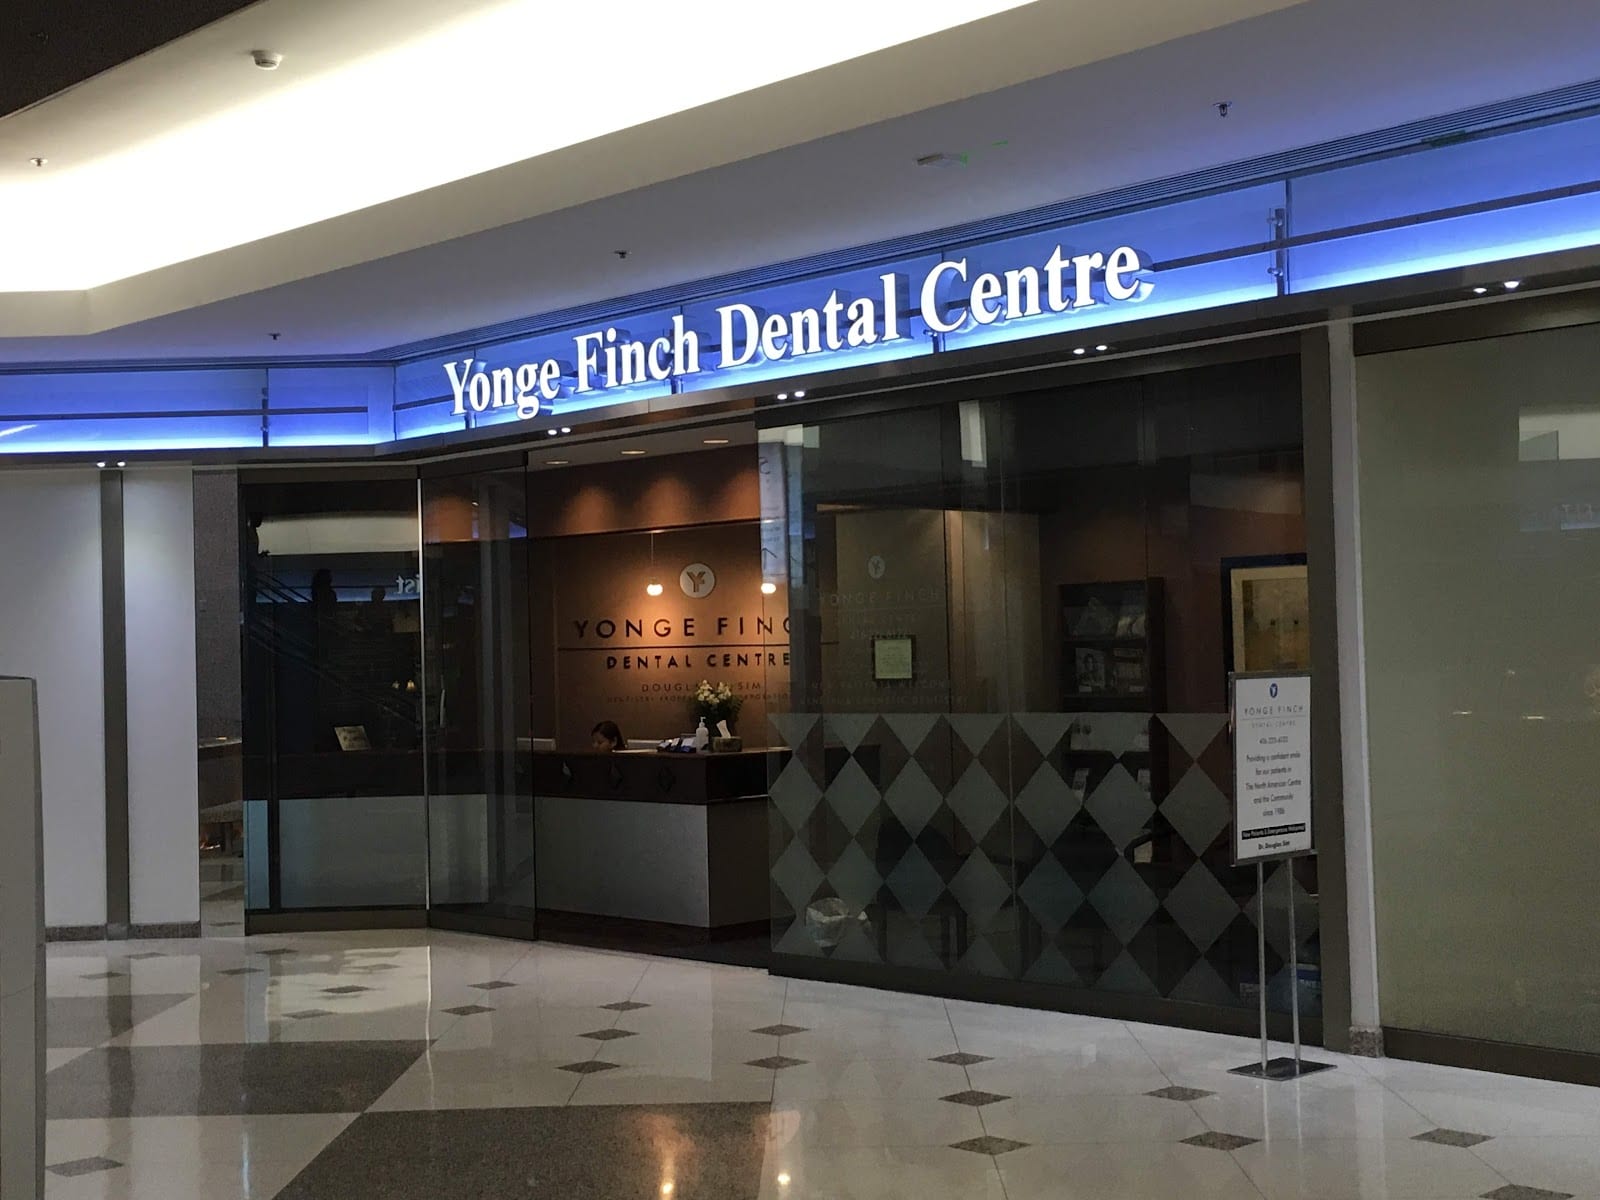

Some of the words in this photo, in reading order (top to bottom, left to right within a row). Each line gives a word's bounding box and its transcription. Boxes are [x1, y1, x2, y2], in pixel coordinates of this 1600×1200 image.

[443, 358, 562, 419] Yonge
[573, 315, 700, 395] Finch
[716, 272, 898, 370] Dental
[921, 244, 1140, 333] Centre
[574, 618, 696, 639] YONGE
[606, 655, 692, 670] DENTAL
[706, 652, 790, 668] CENTRE
[1244, 706, 1273, 716] YONGE
[1277, 704, 1304, 713] FINCH
